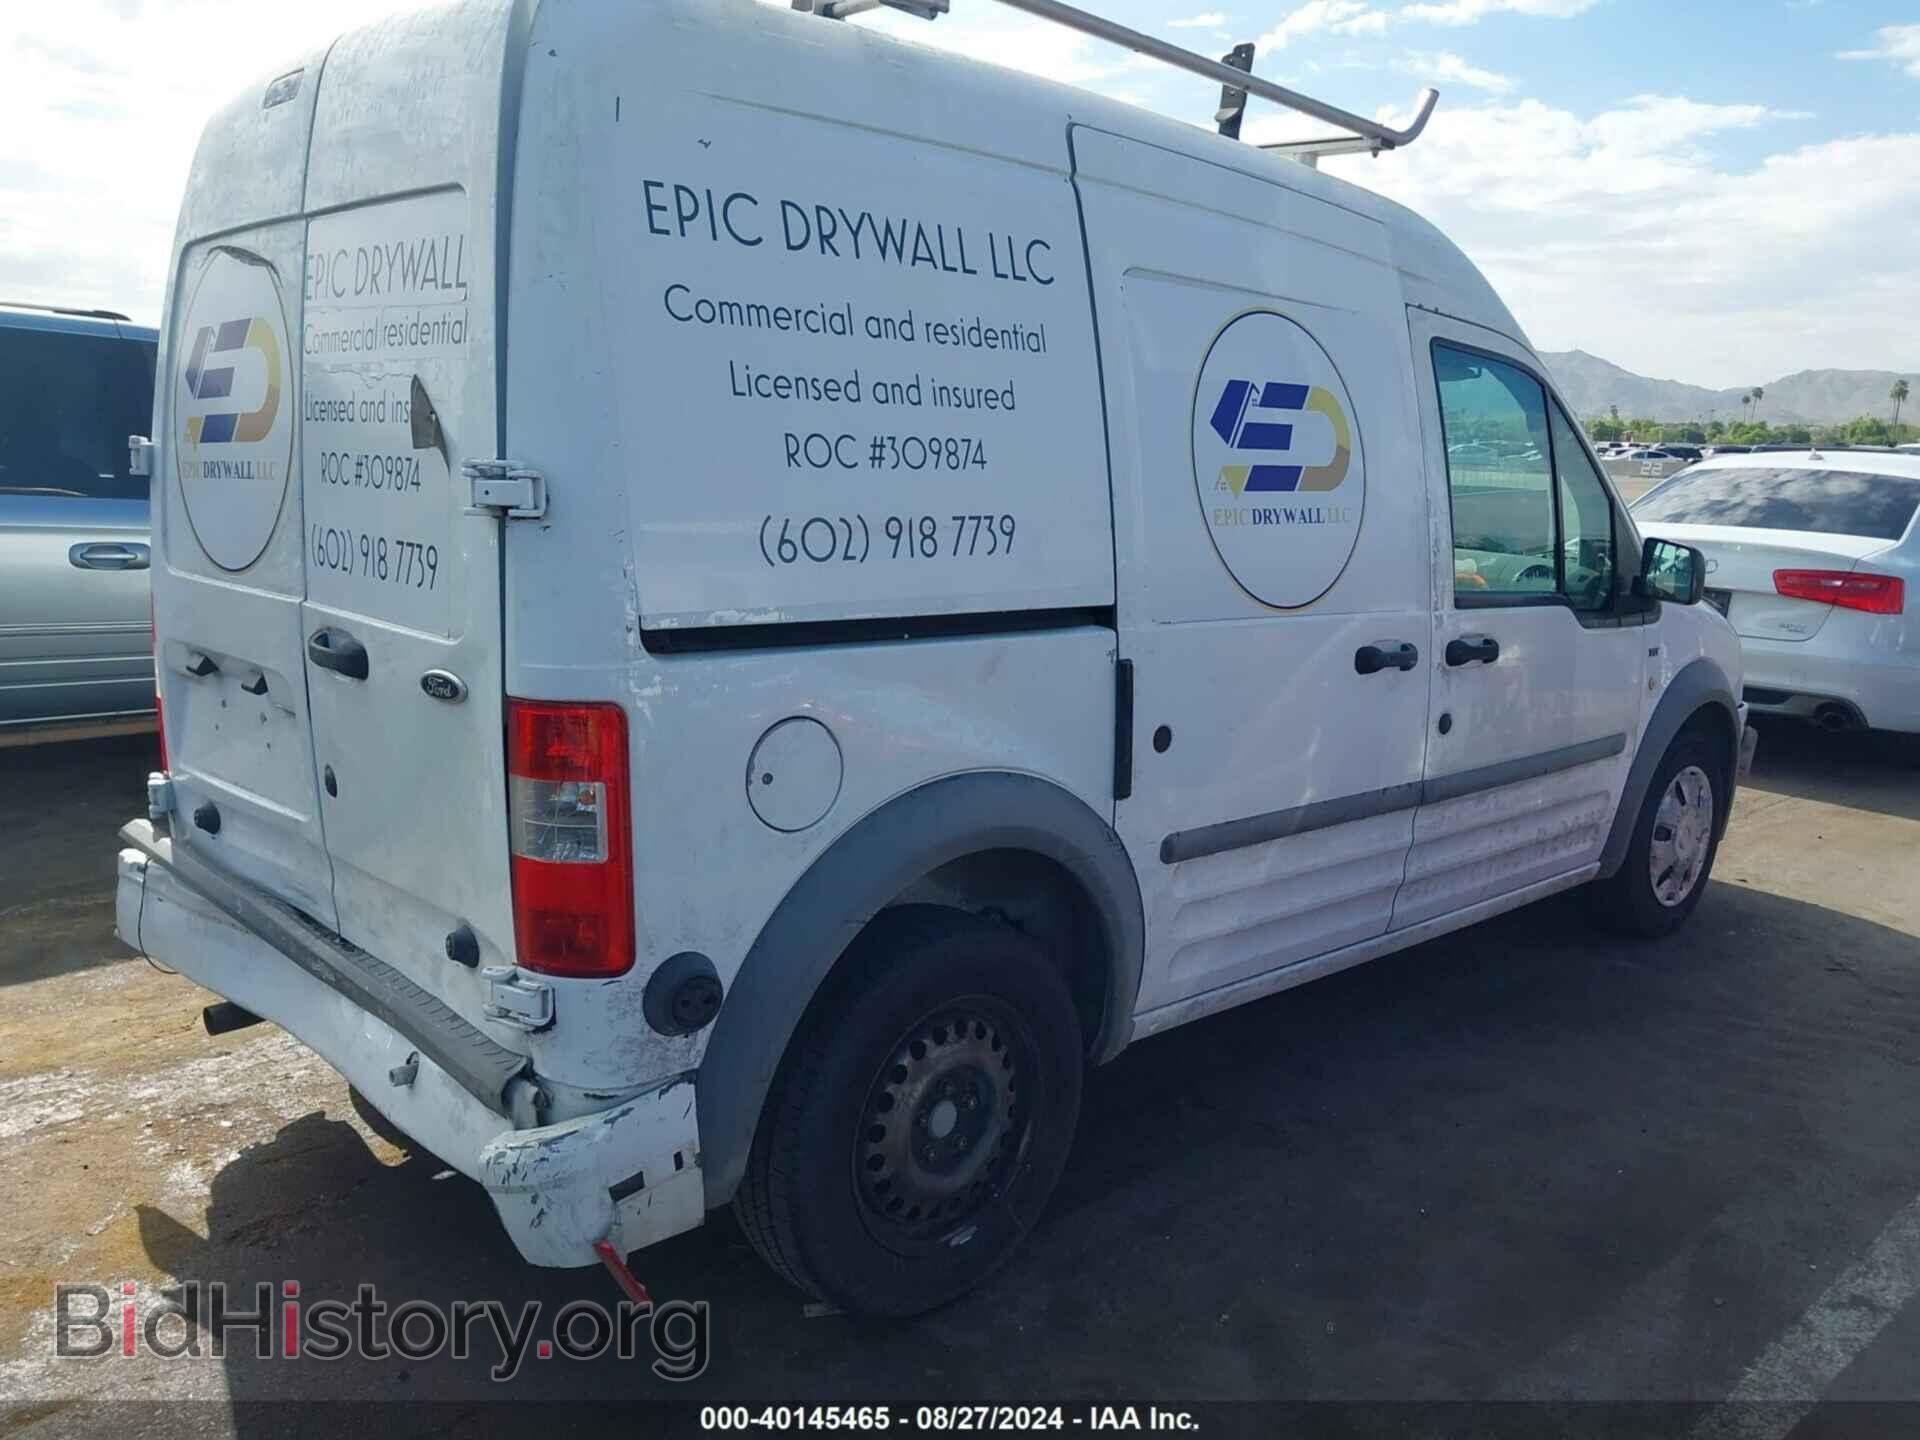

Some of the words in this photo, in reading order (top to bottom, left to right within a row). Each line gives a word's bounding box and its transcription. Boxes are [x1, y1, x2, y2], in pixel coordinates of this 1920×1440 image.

[642, 179, 764, 247] EPIC
[780, 199, 978, 276] DRYWALL
[988, 231, 1055, 286] LLC
[304, 247, 349, 301] EPIC
[354, 233, 468, 297] DRYWALL
[303, 315, 379, 355] Commercial
[383, 307, 469, 348] residential
[663, 283, 855, 337] Commercial
[864, 309, 916, 342] and
[924, 316, 1048, 354] residential
[304, 389, 355, 423] Licensed
[359, 389, 386, 423] and
[729, 359, 861, 403] Licensed
[872, 373, 922, 407] and
[931, 377, 1016, 411] insured
[202, 460, 255, 480] DRYWALL
[320, 451, 350, 486] ROC
[354, 454, 421, 493] #309874
[784, 431, 859, 469] ROC
[868, 434, 988, 471] #309874
[759, 513, 870, 567] (602)
[884, 515, 939, 559] 918
[950, 513, 1017, 558] 7739
[1213, 508, 1250, 526] EPIC
[1251, 507, 1325, 526] DRYWALL
[1327, 507, 1351, 525] LLC
[311, 523, 354, 575] (602)
[360, 533, 388, 581] 918
[395, 539, 439, 590] 7739
